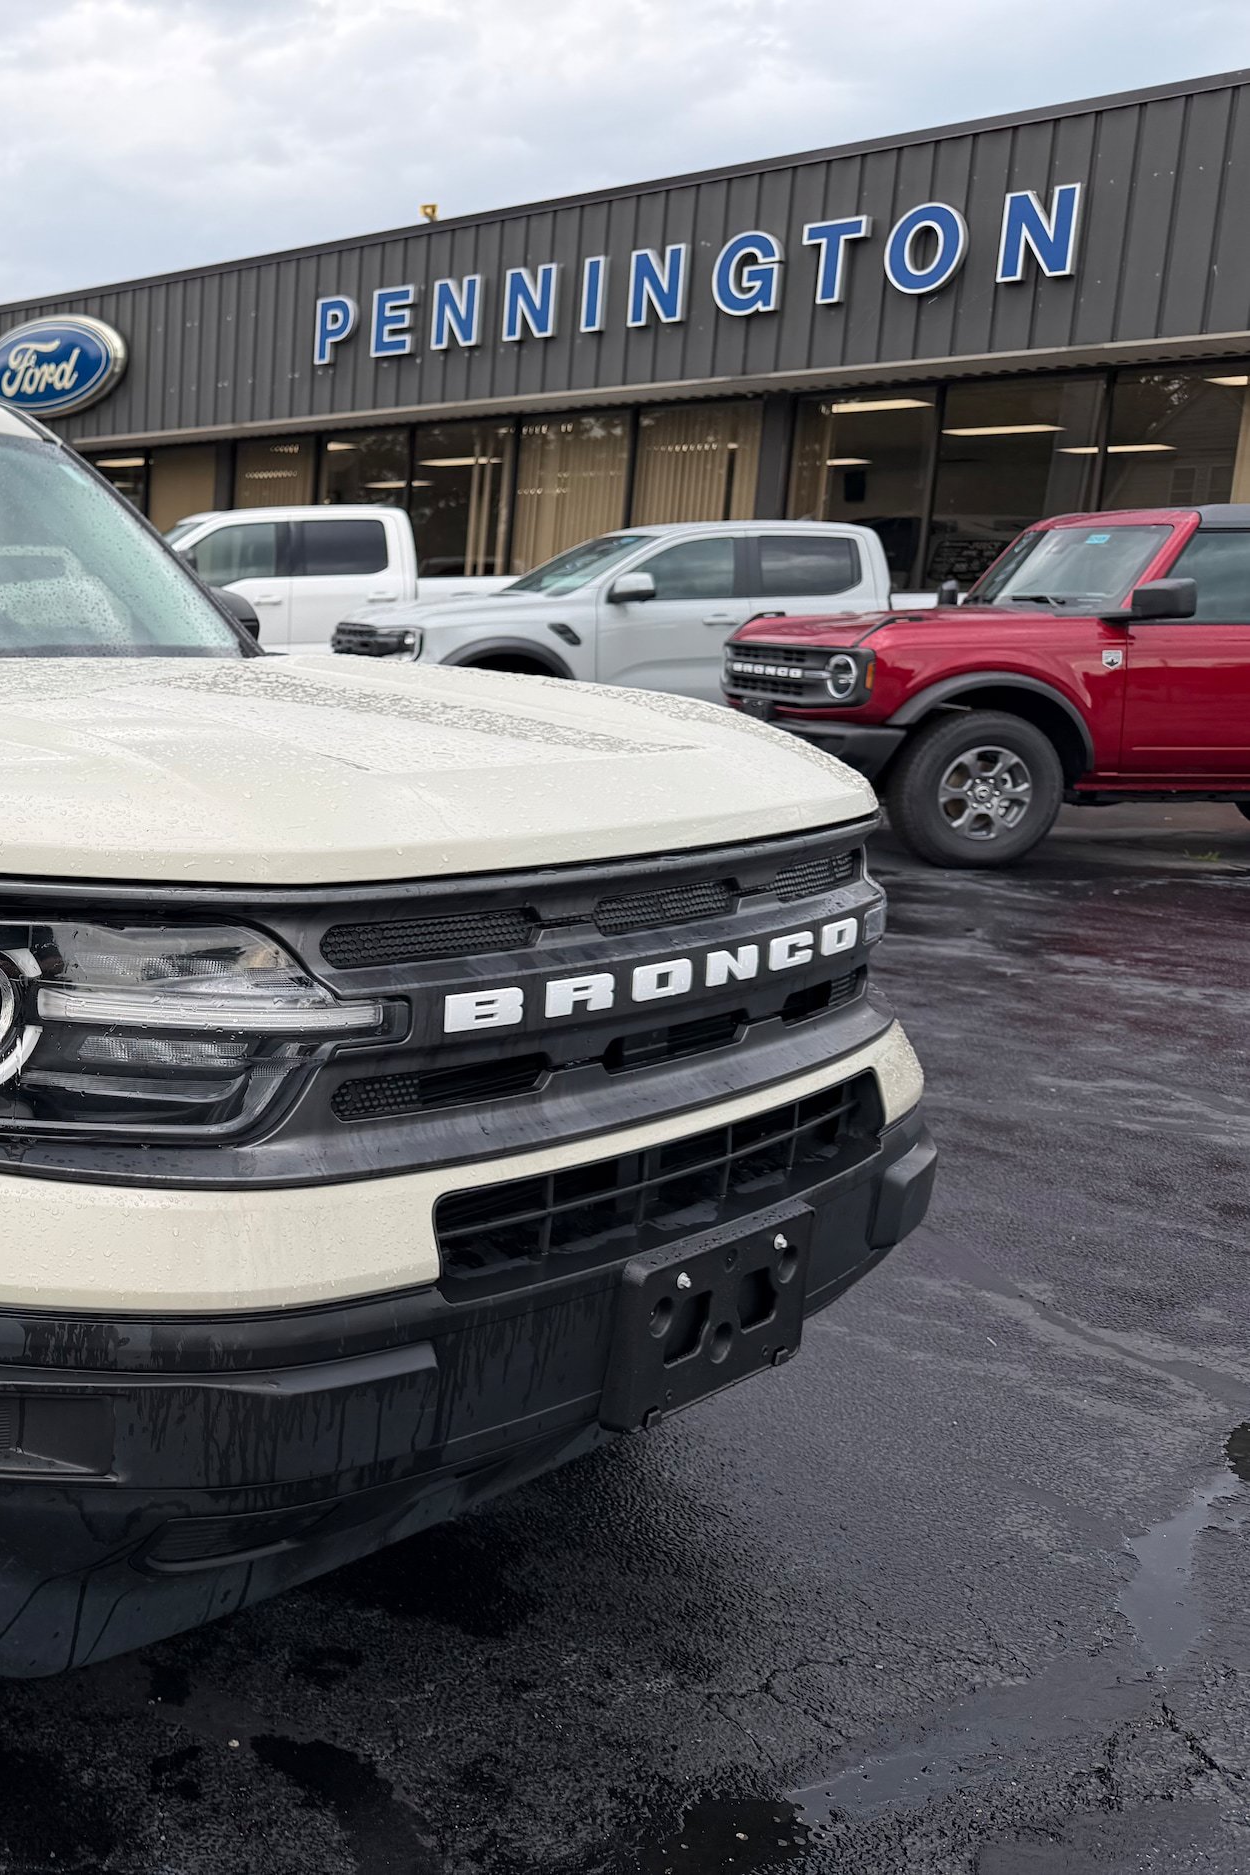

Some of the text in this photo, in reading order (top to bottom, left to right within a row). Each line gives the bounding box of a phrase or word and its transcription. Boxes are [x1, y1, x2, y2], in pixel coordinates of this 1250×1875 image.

[312, 182, 1082, 366] PENNINGTON
[1, 337, 82, 398] Ford
[732, 661, 804, 679] BRONCO
[443, 916, 859, 1034] BRONCO
